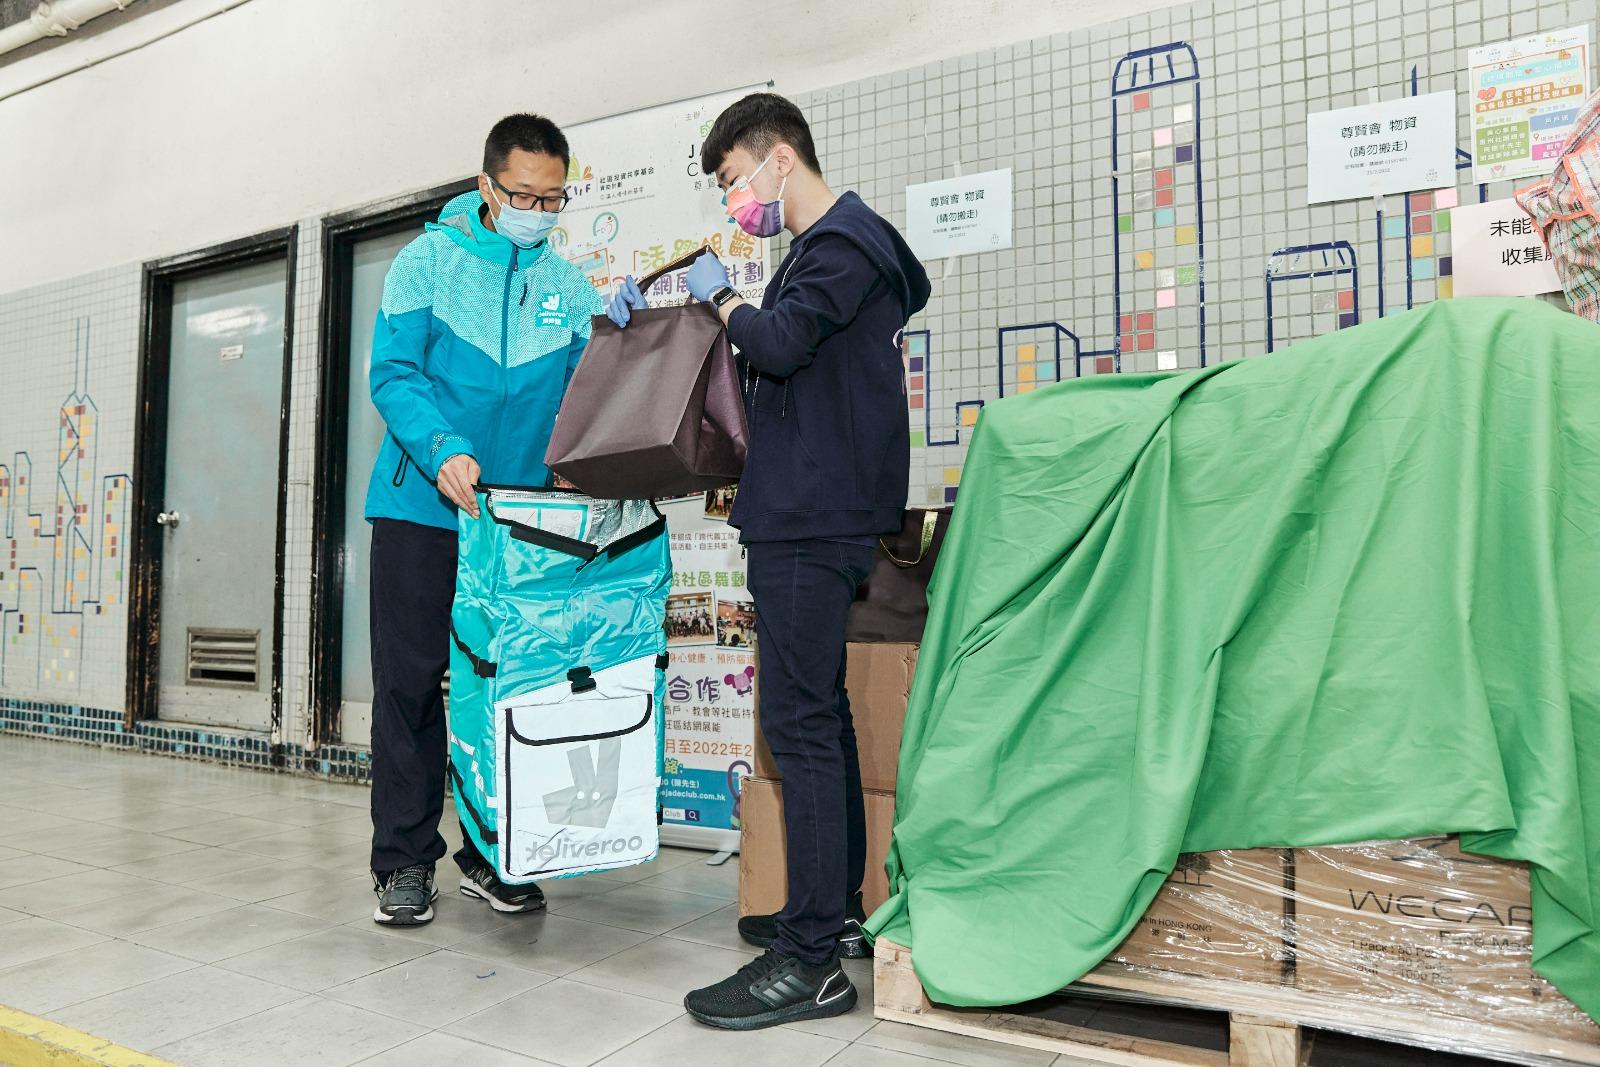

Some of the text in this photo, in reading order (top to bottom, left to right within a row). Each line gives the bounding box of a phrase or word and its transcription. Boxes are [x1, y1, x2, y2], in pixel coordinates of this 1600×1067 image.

[1341, 116, 1417, 138] 尊賢會 物資
[1349, 140, 1408, 158] (請勿搬走)
[965, 190, 985, 202] 物資
[1490, 217, 1538, 237] 未能
[668, 675, 721, 703] 合作
[665, 705, 754, 719] 商戶、教會等社區持
[661, 789, 726, 801] ejadeclub.com.hk
[1158, 918, 1184, 929] HONG
[1186, 923, 1212, 933] KONG
